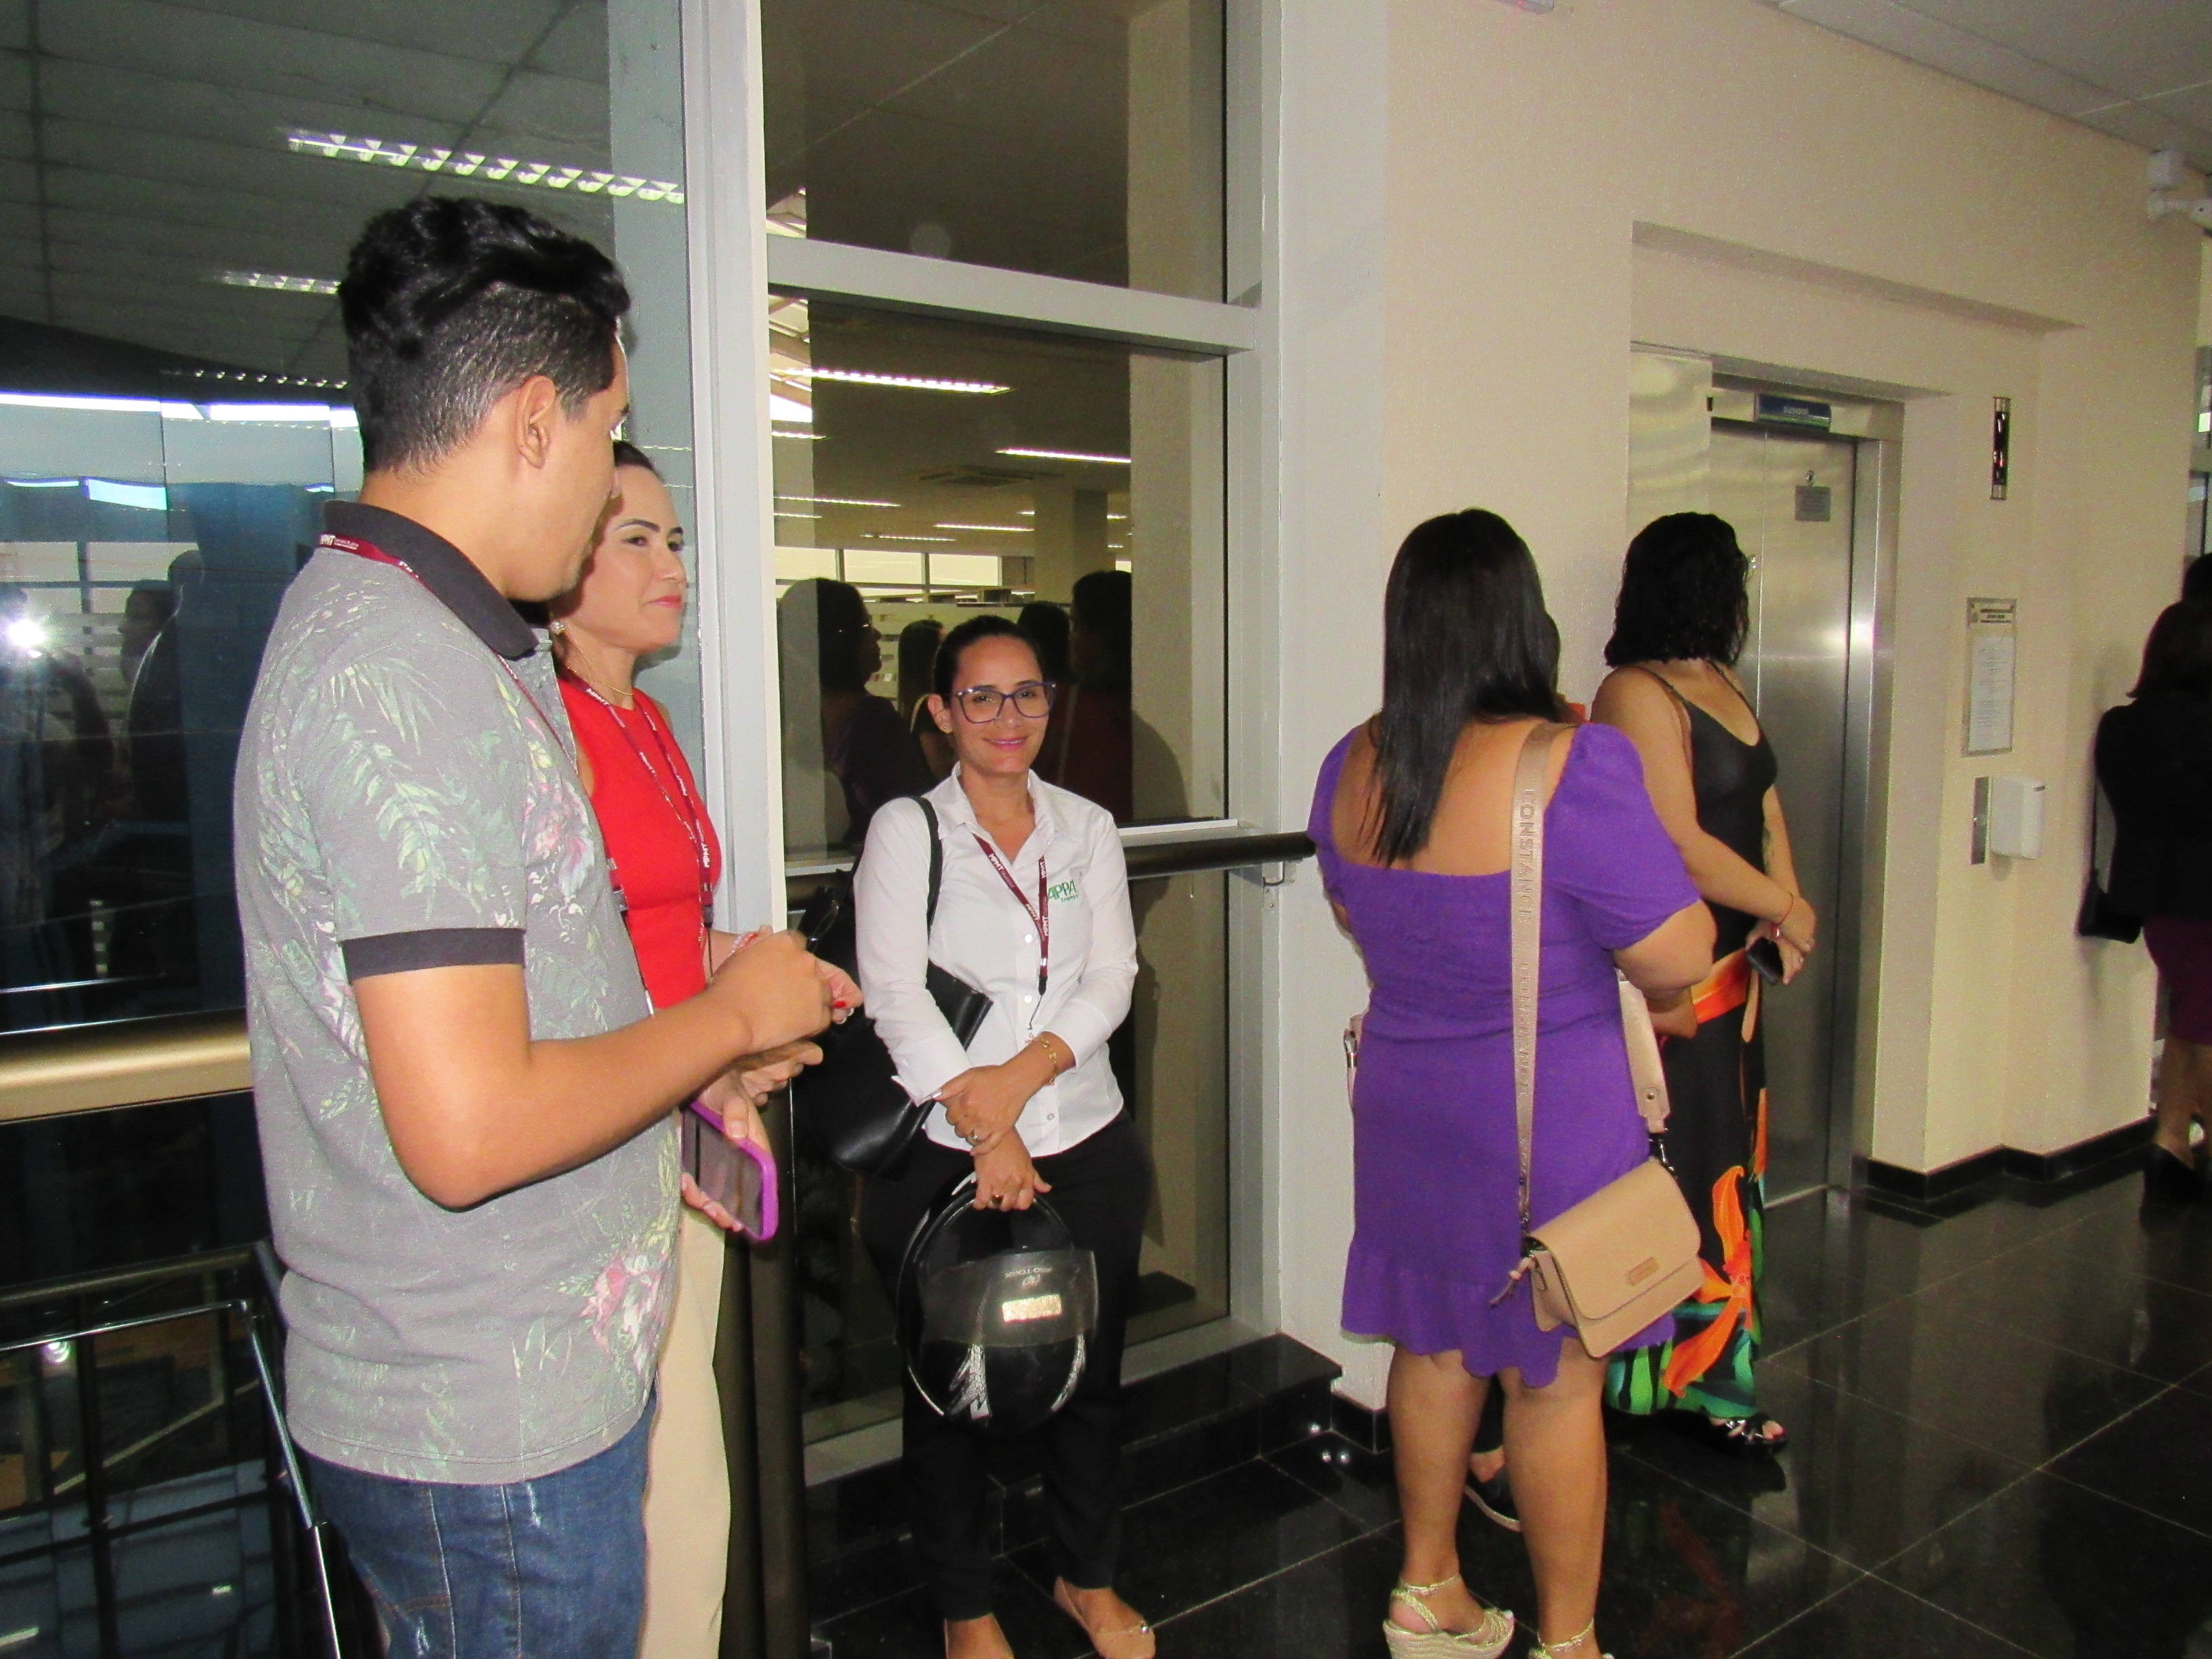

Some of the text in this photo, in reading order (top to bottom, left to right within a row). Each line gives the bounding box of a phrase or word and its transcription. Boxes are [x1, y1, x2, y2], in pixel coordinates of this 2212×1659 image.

[586, 688, 611, 705] MPMT
[701, 842, 710, 868] MPMT
[988, 853, 1004, 871] MPMT
[1048, 879, 1077, 900] APPA
